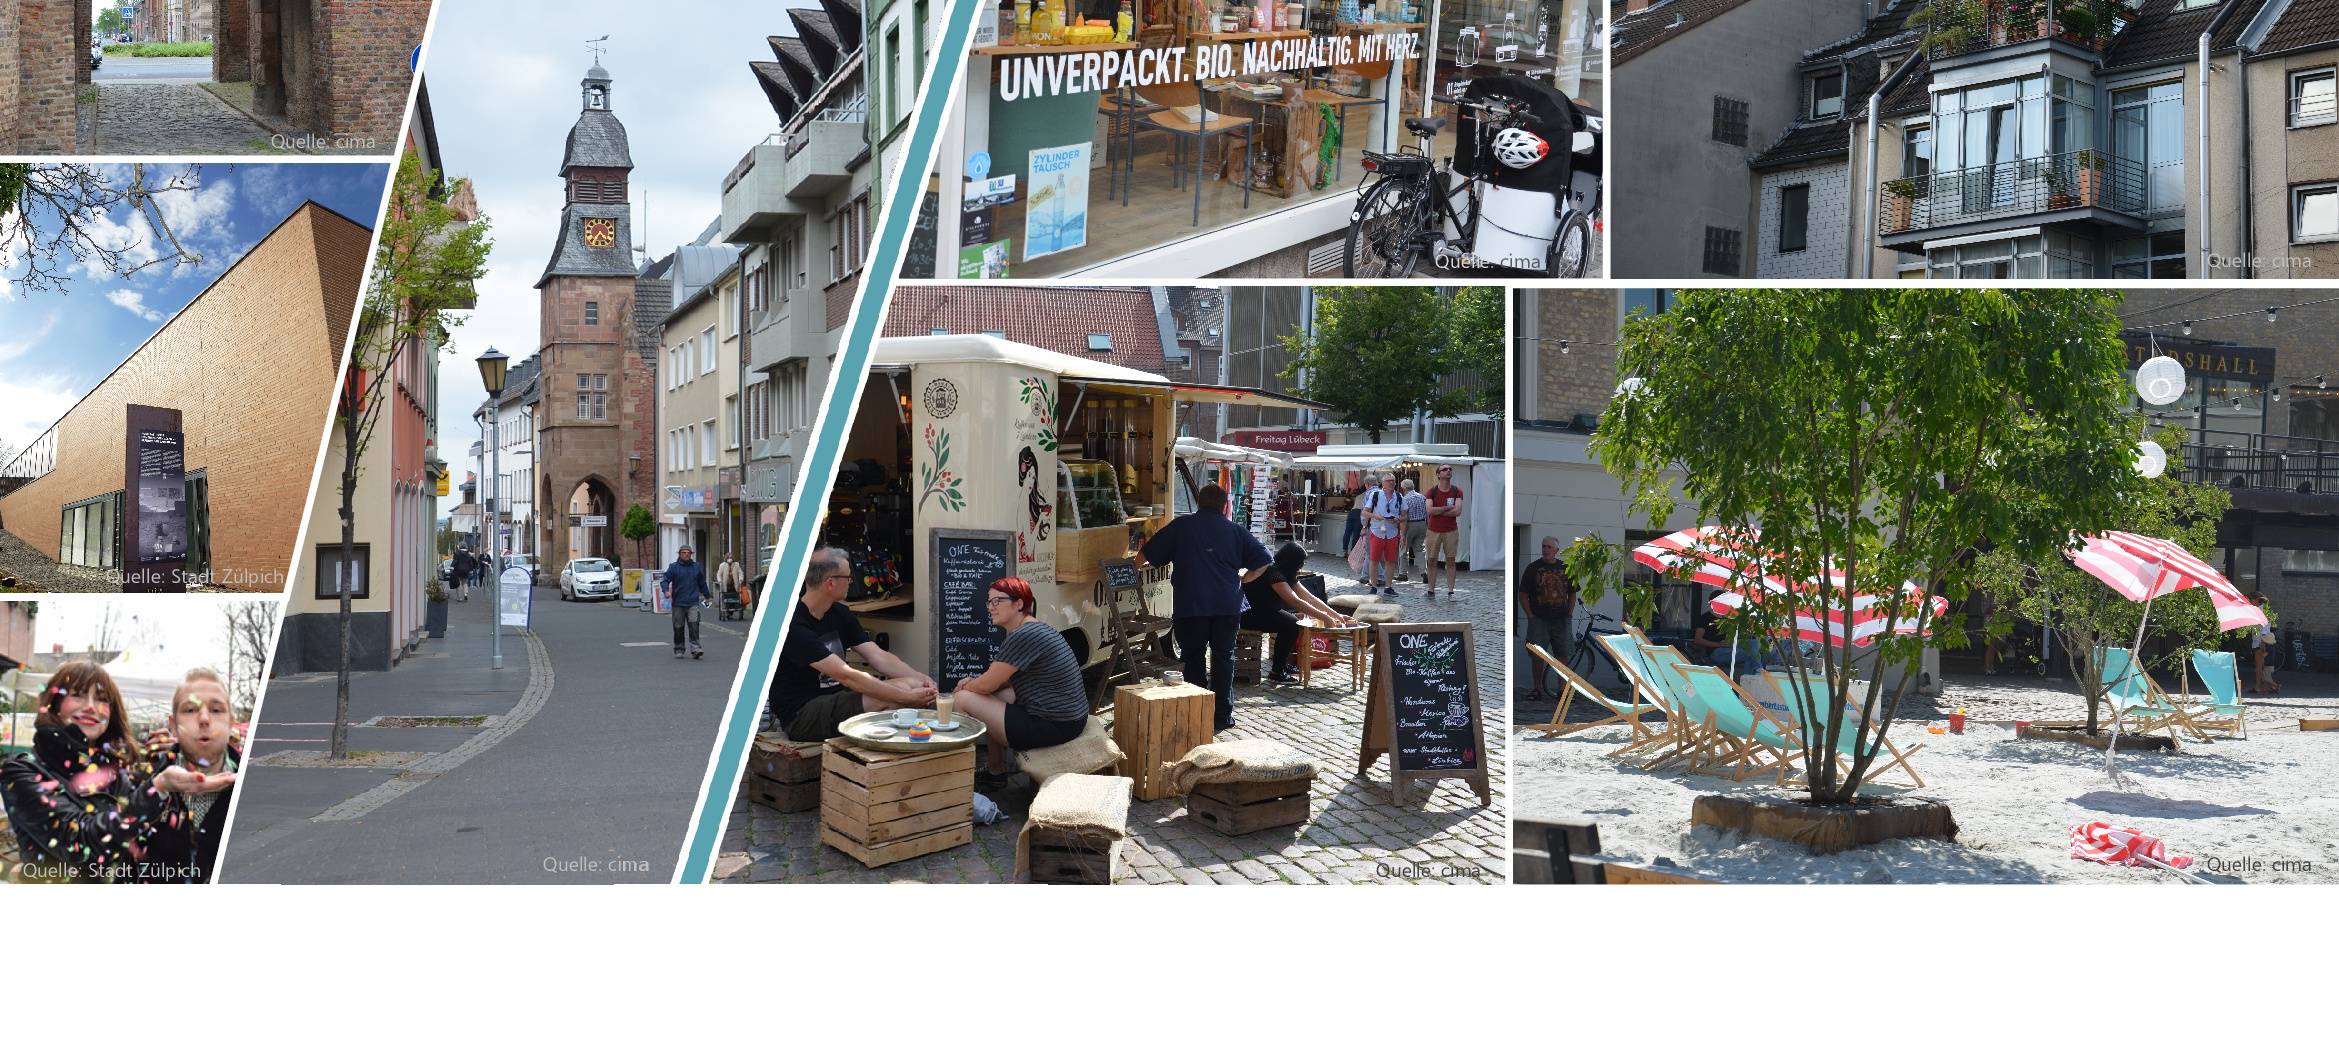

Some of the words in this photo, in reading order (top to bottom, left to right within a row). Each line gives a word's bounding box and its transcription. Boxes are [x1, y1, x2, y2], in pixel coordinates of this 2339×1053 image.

[1000, 47, 1190, 102] UNVERPACKT.
[1196, 44, 1236, 80] BIO.
[1243, 36, 1354, 75] NACHHALTIG.
[1358, 34, 1384, 63] MIT
[1386, 32, 1420, 60] HERZ.
[1033, 149, 1080, 164] ZYLINDER
[1033, 161, 1070, 173] TAUSCH
[1255, 434, 1287, 449] Freitag
[1289, 434, 1321, 445] Lübeck
[948, 544, 970, 557] ONE
[1146, 564, 1171, 585] TRADE
[1399, 633, 1428, 649] ONE
